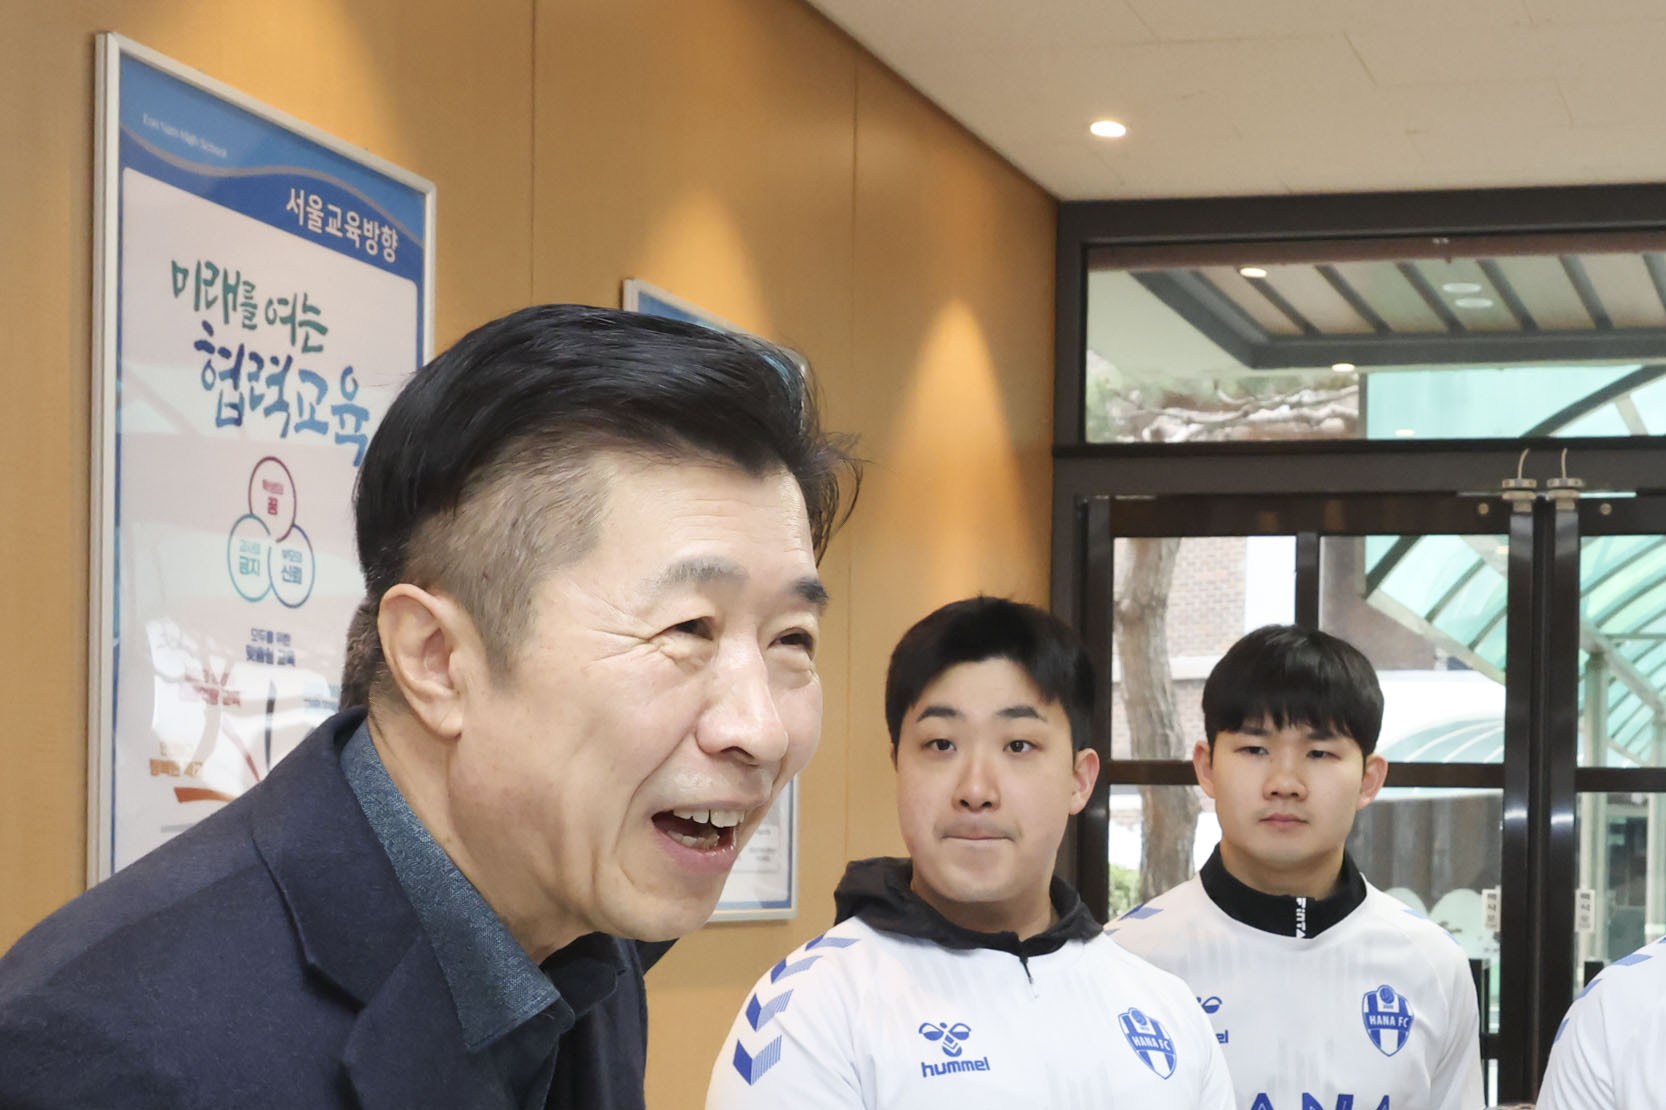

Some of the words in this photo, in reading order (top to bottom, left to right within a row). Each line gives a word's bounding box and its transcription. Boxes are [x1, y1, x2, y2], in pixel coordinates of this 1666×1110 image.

[286, 187, 399, 263] 서울교육방향
[171, 260, 258, 331] 미래를
[265, 292, 329, 353] 여는
[193, 320, 370, 467] 협력교육
[1131, 1035, 1158, 1049] HANA
[1158, 1037, 1171, 1050] FC
[1369, 1015, 1395, 1026] HANA
[1398, 1016, 1409, 1028] FC
[921, 1056, 990, 1078] hummel
